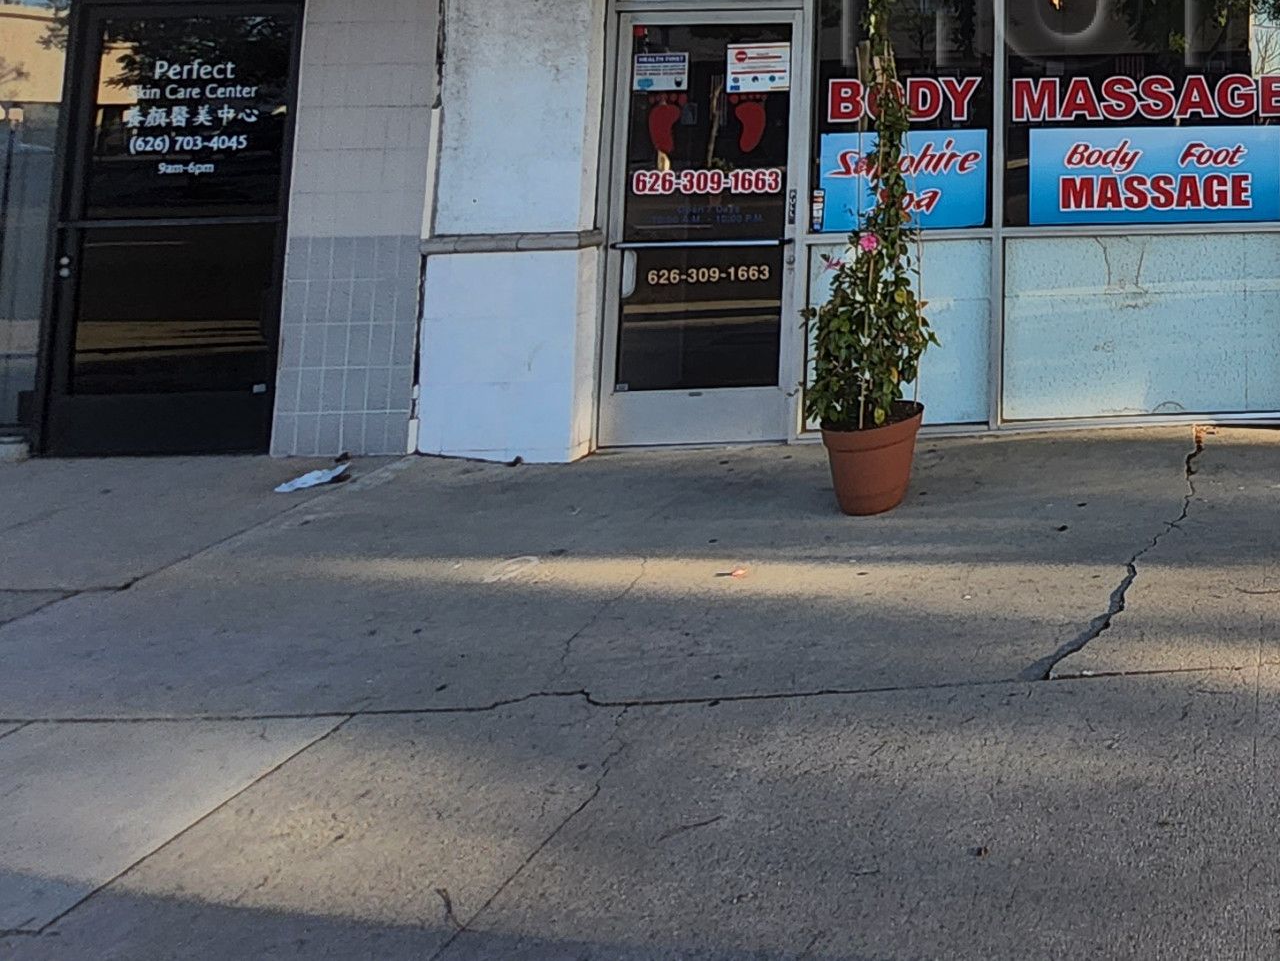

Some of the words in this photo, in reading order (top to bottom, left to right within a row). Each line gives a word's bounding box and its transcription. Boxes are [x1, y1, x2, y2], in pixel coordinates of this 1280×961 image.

[153, 59, 236, 80] Perfect
[165, 84, 201, 99] Care
[205, 84, 258, 99] Center
[129, 135, 170, 154] (626)
[174, 134, 248, 152] 703-4045
[1064, 138, 1143, 173] Body
[1178, 141, 1249, 168] Foot
[823, 137, 982, 185] Saphire
[632, 168, 782, 194] 626-309-1663
[1059, 173, 1253, 212] MASSAGE
[647, 265, 770, 285] 626-309-1663
